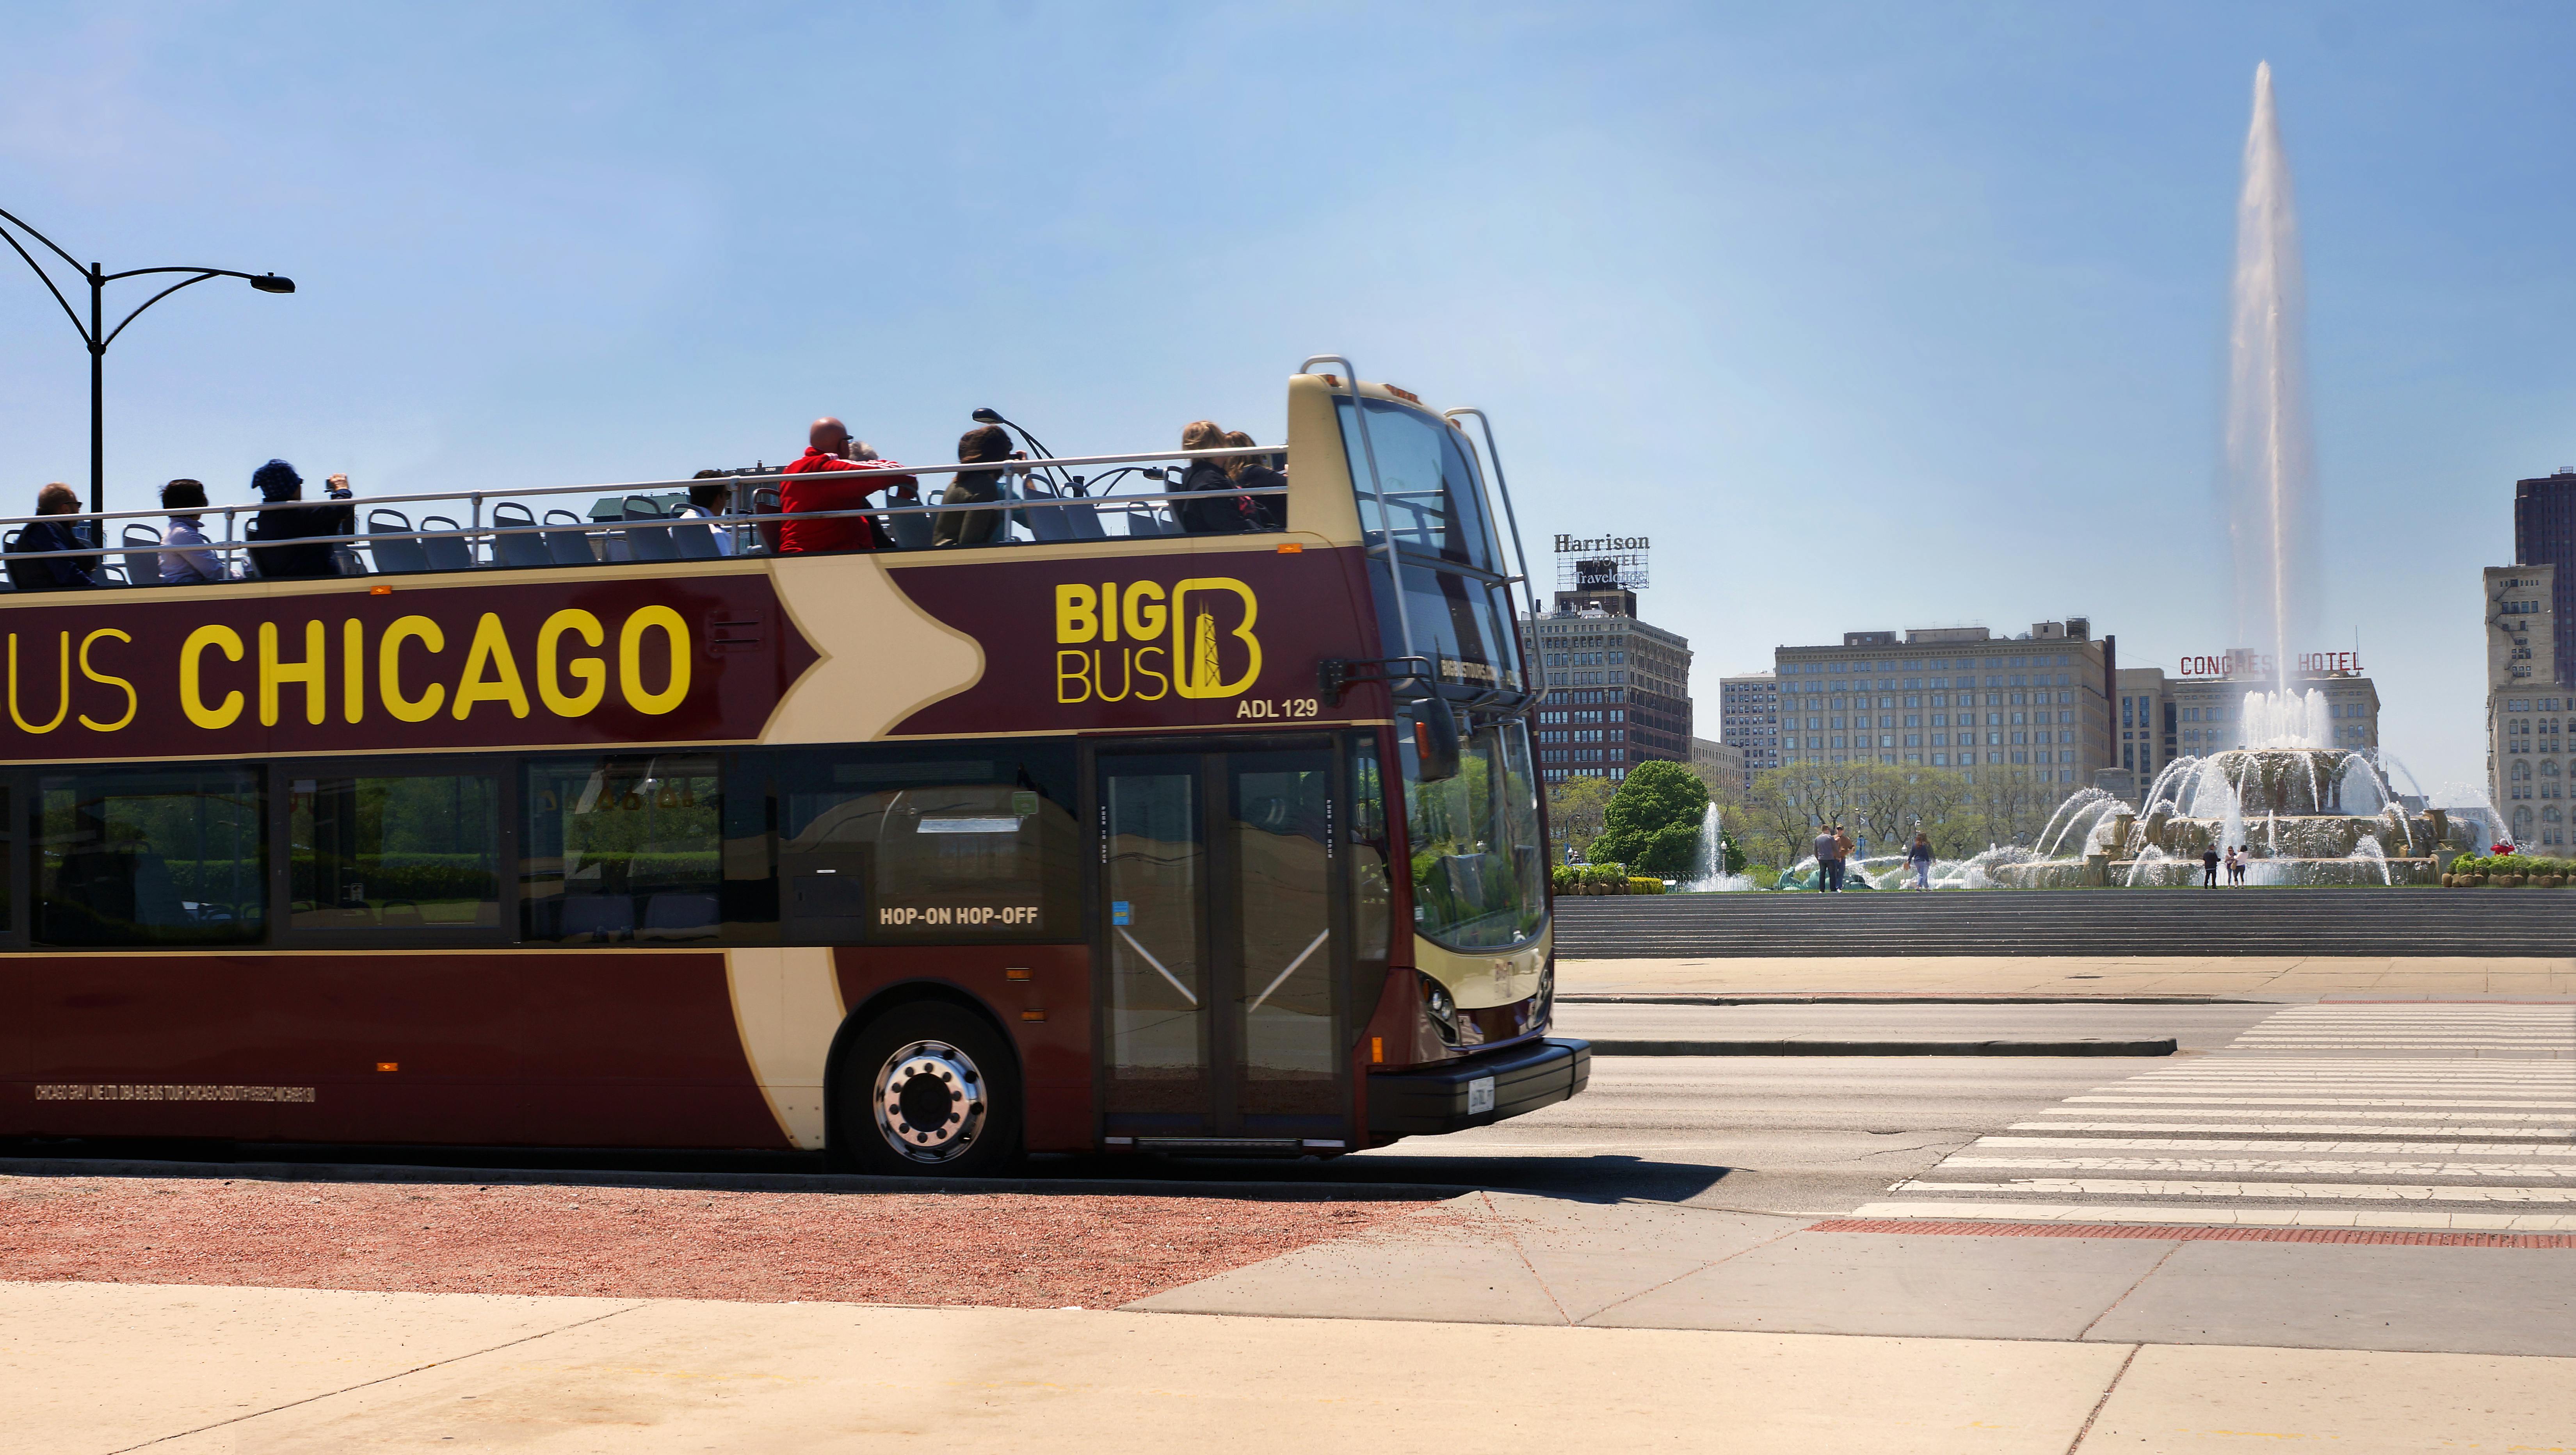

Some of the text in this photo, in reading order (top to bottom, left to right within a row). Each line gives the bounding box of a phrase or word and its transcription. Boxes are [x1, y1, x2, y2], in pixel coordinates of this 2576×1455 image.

[1554, 534, 1650, 552] Harrison
[1592, 554, 1639, 567] HOTEL
[1575, 569, 1646, 585] Travelodge
[1055, 580, 1167, 644] BIG
[8, 605, 691, 734] US CHICAGO
[2181, 652, 2364, 675] CONGRES HOTEL
[1057, 646, 1169, 703] BUS
[1236, 698, 1318, 718] ADL 129
[881, 907, 1038, 924] HOP-ON HOP-OFF
[35, 1085, 68, 1100] CHICAGO
